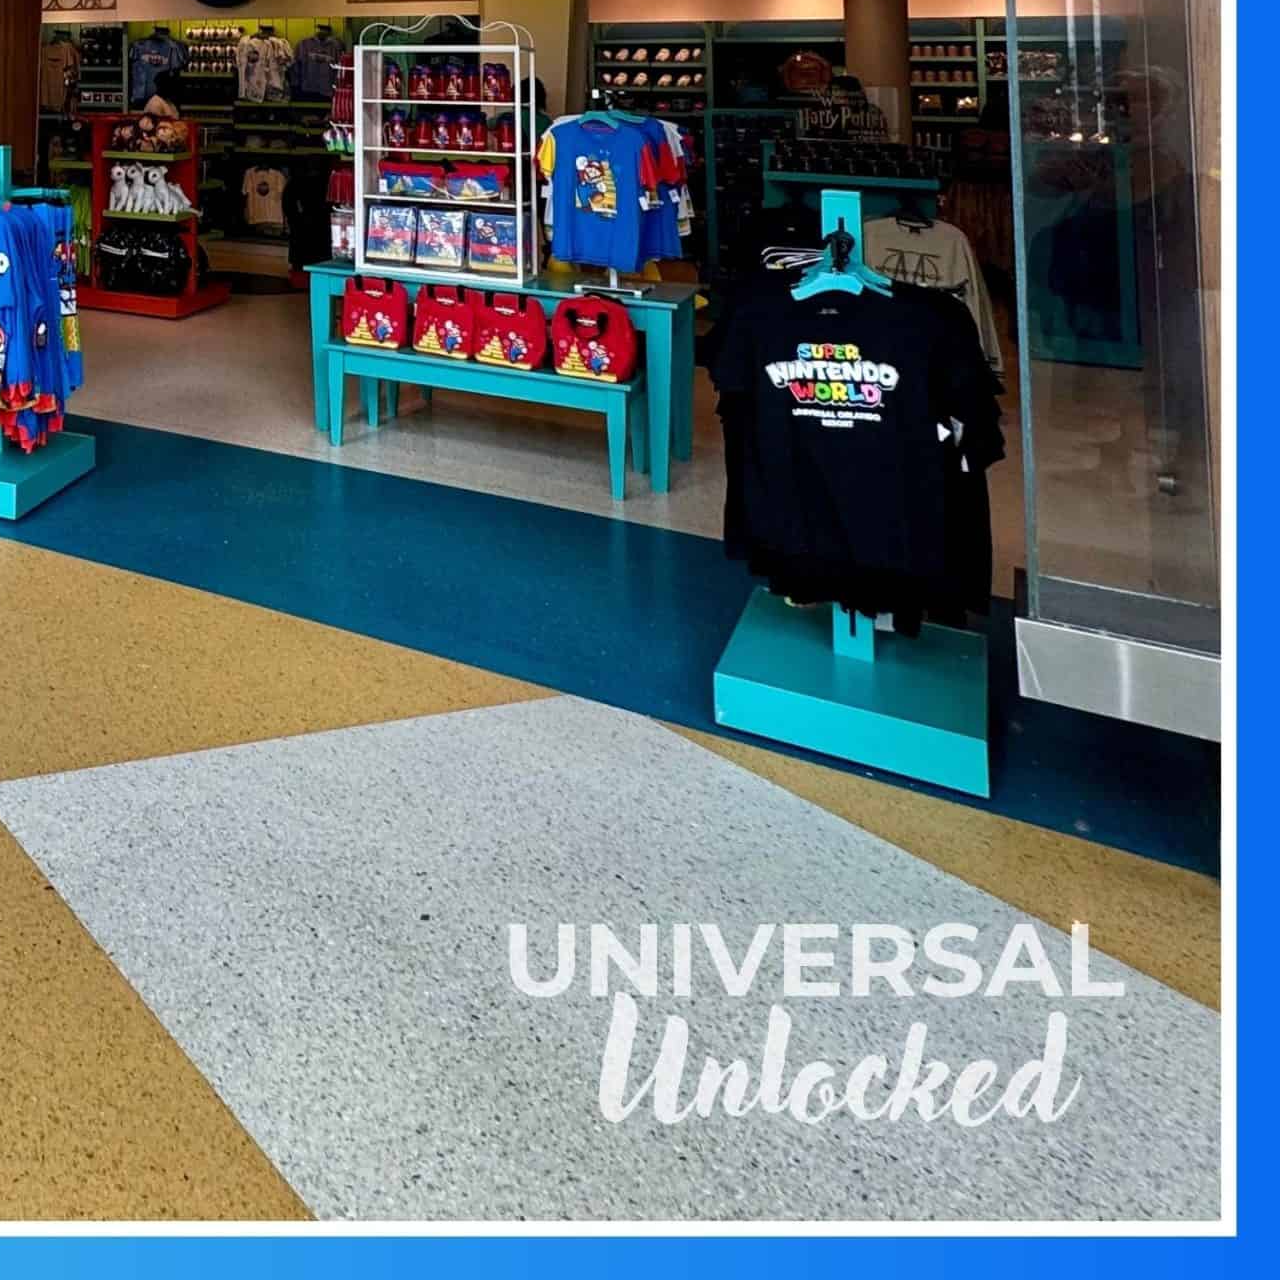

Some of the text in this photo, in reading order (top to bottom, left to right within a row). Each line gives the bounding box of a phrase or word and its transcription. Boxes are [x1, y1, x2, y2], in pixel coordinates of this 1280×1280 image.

[797, 342, 861, 360] SUPER
[765, 359, 900, 390] NINTENDO
[788, 380, 882, 407] WORLD
